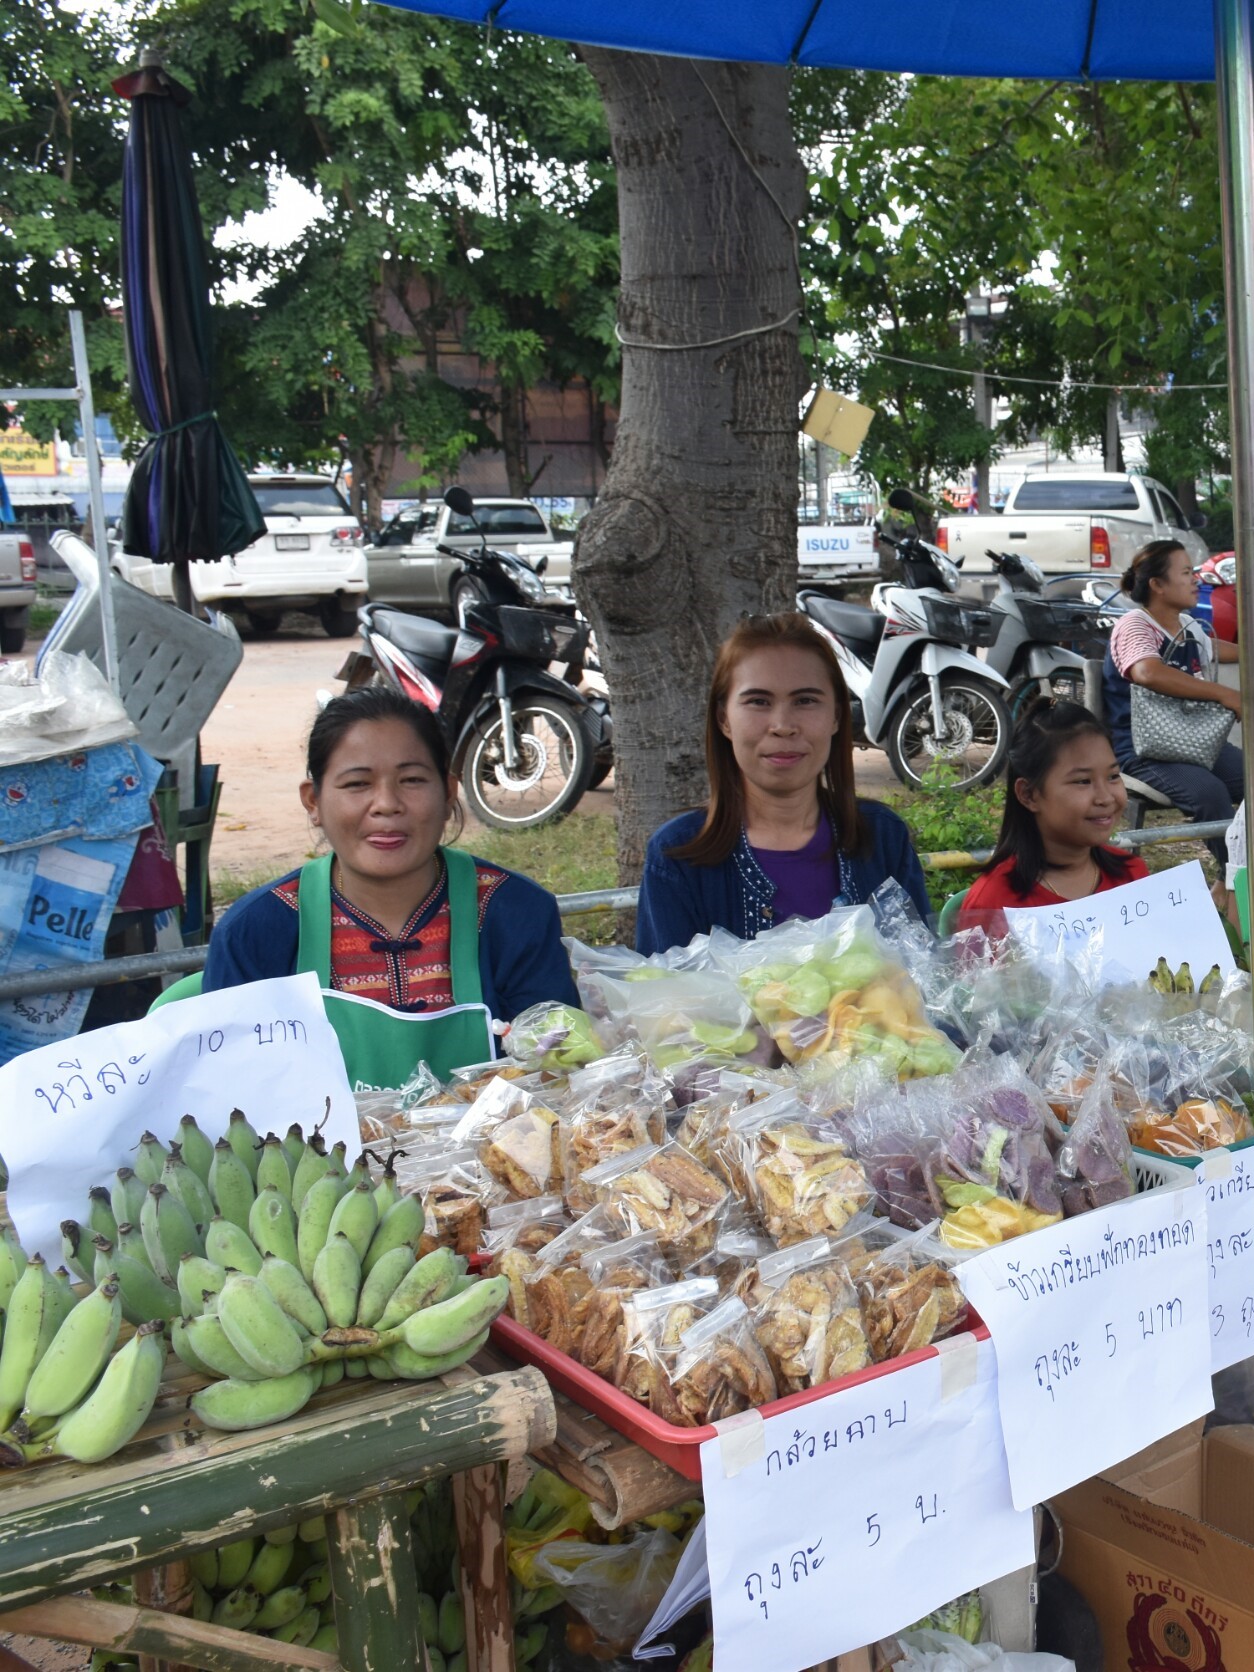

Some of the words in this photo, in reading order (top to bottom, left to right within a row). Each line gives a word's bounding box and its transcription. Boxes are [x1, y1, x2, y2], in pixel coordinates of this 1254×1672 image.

[806, 539, 849, 551] ISUZU
[1120, 900, 1149, 926] 20
[34, 1053, 151, 1113] หวีละ
[197, 1030, 224, 1056] 10
[254, 1020, 309, 1044] บาท
[1212, 1304, 1225, 1337] 3
[1034, 1341, 1081, 1402] ถุงละ
[1105, 1322, 1117, 1358] 5
[1138, 1298, 1182, 1340] บาท
[744, 1537, 825, 1619] ถุงละ
[866, 1513, 881, 1548] 5
[1126, 1570, 1153, 1592] สุรา
